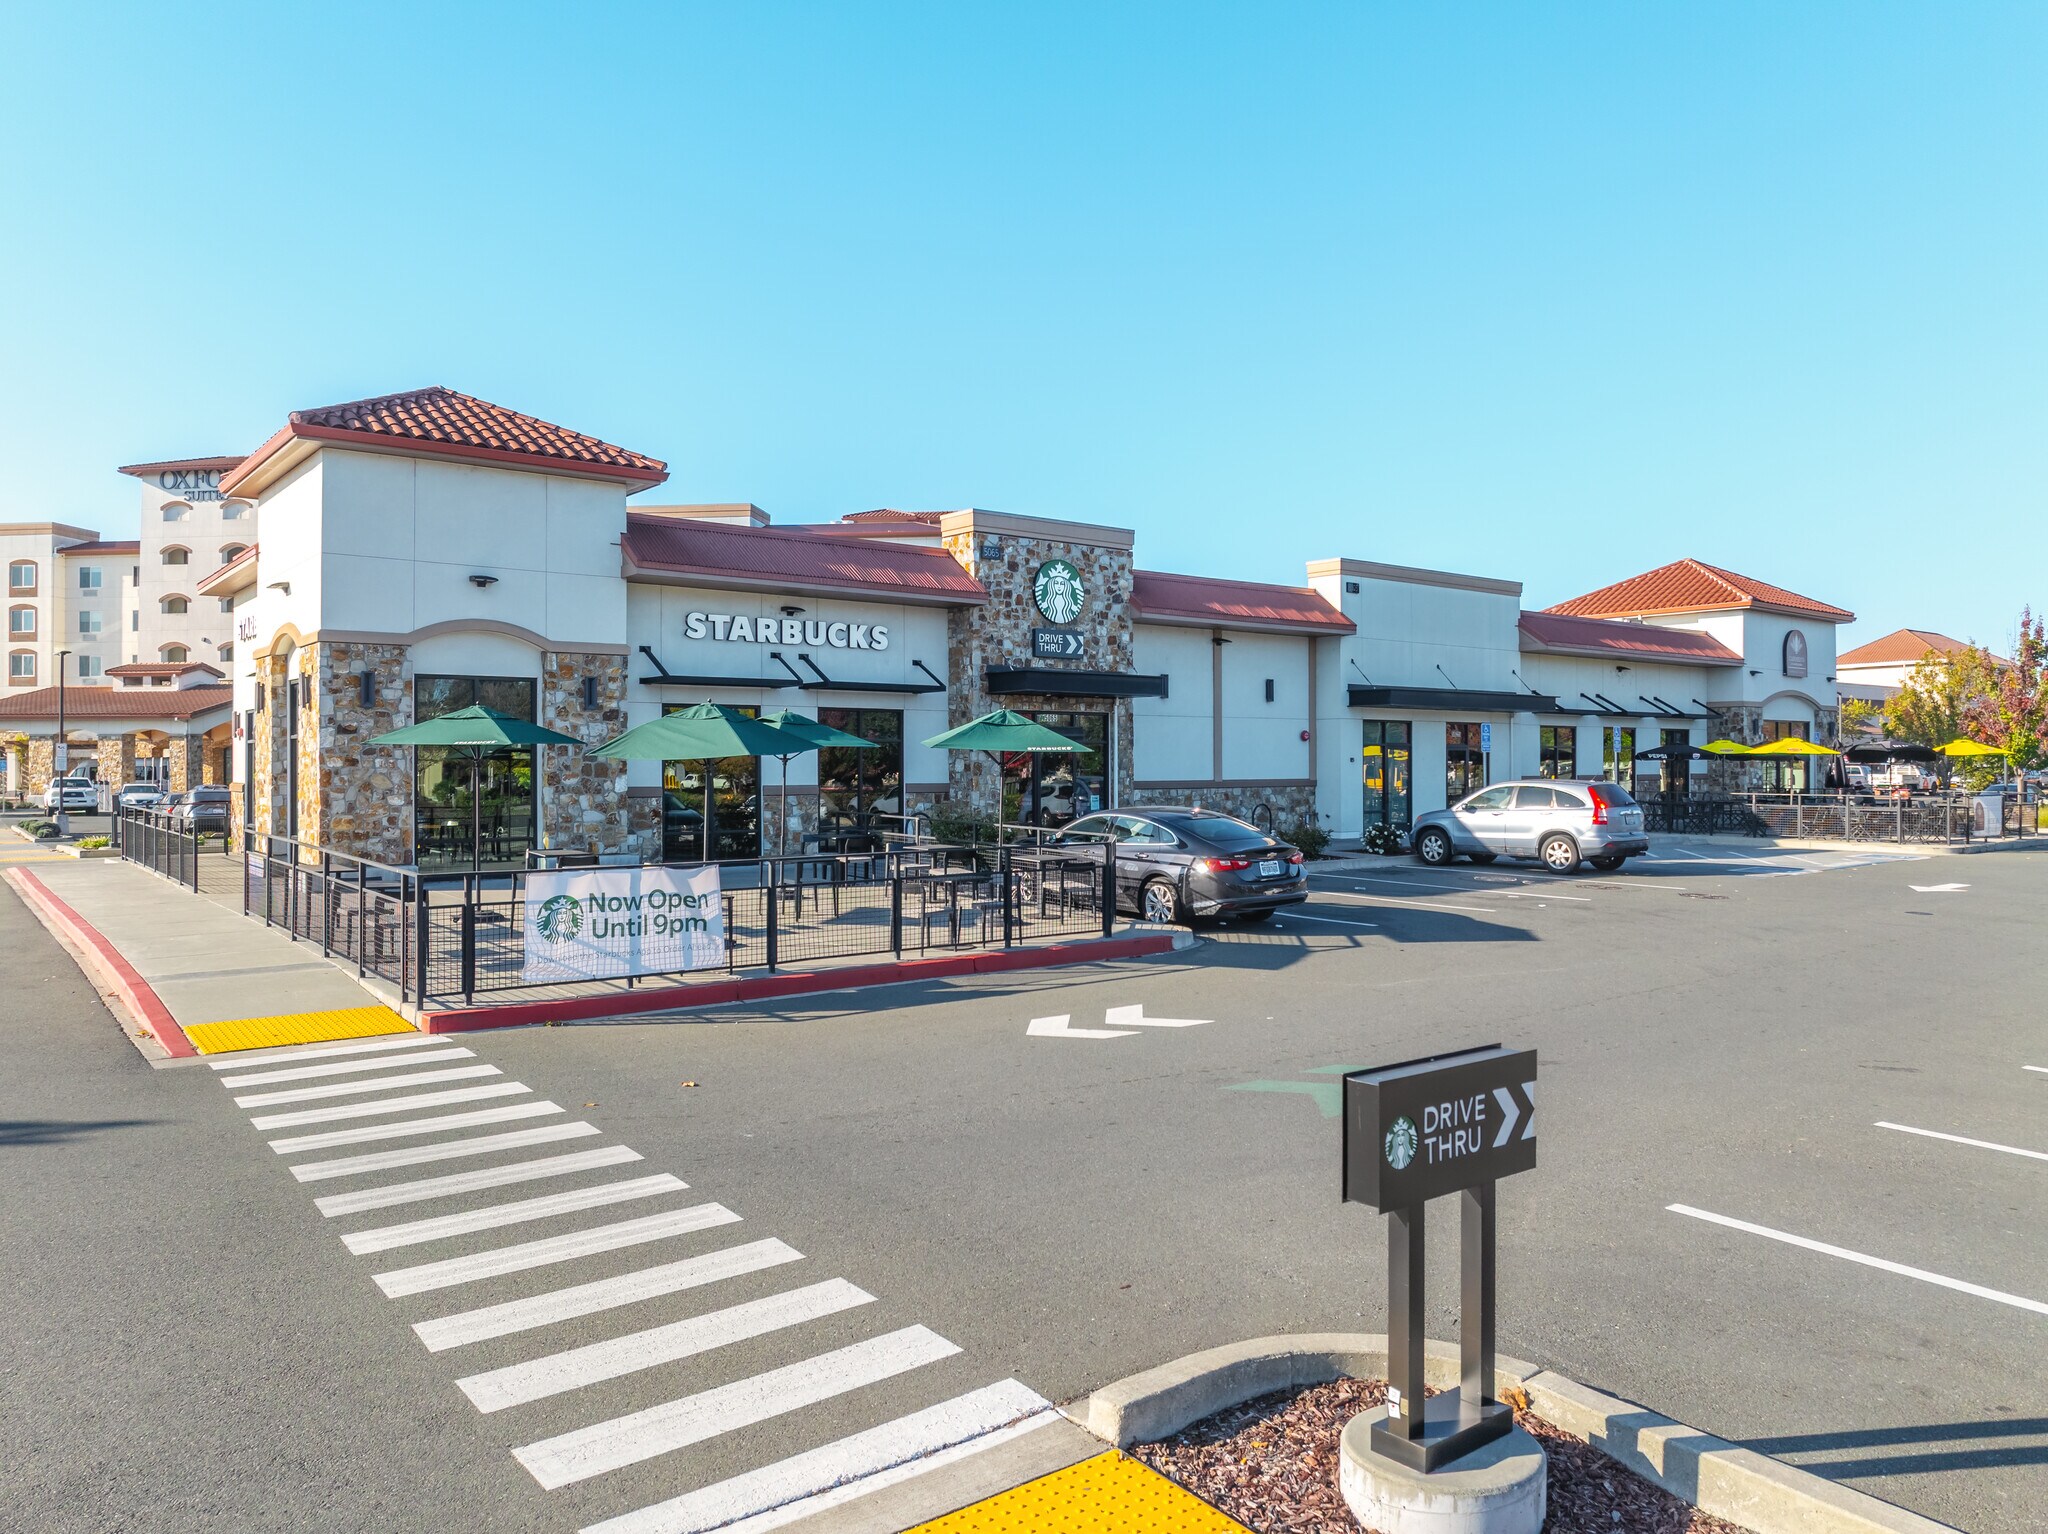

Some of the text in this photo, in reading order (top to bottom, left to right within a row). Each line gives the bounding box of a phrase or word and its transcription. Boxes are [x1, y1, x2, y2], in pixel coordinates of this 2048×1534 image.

[159, 469, 228, 489] OXFO
[685, 612, 889, 651] STARBUCKS
[1038, 633, 1064, 644] DRIVE
[1039, 643, 1062, 653] THRU
[588, 888, 709, 914] Now Open
[591, 913, 708, 939] Until 9pm
[595, 949, 635, 959] Starbucks
[636, 947, 651, 957] App
[663, 944, 685, 953] Order
[1423, 1093, 1486, 1135] DRIVE
[1423, 1125, 1482, 1165] THRU
